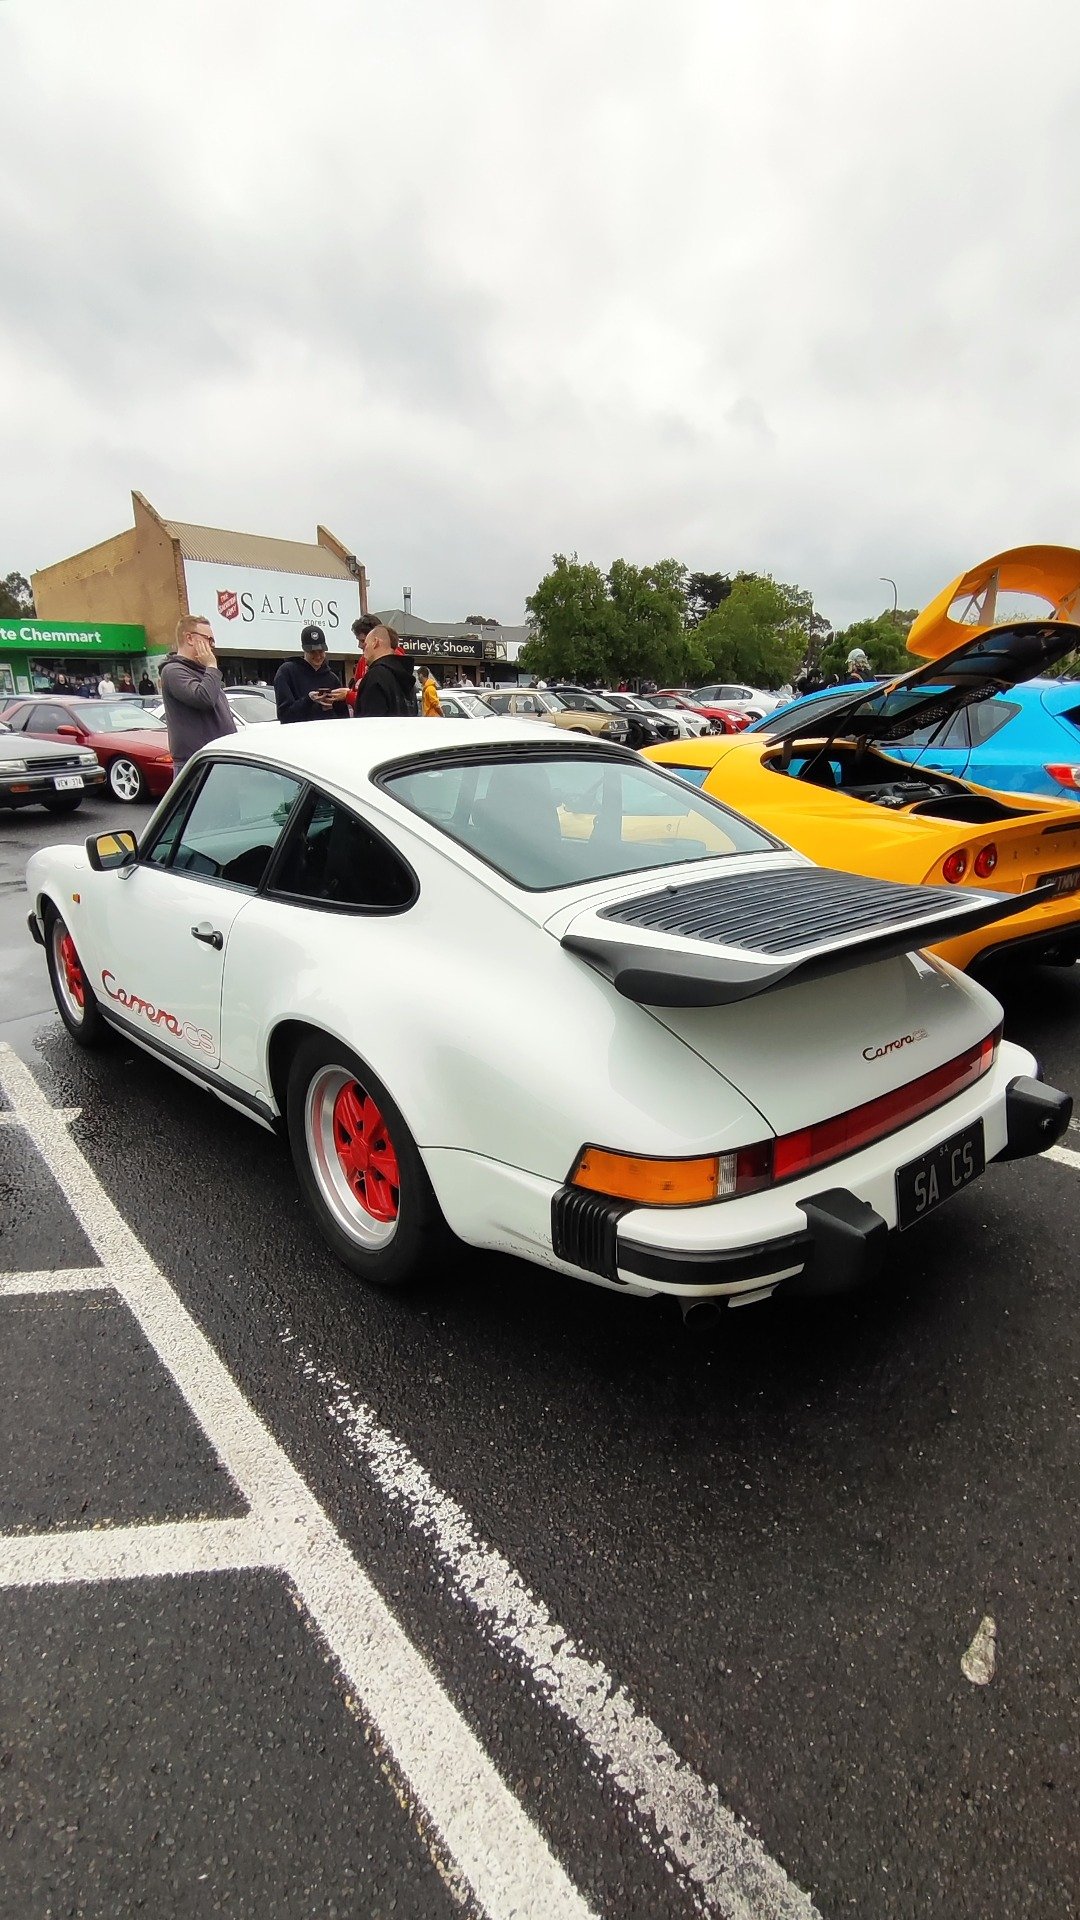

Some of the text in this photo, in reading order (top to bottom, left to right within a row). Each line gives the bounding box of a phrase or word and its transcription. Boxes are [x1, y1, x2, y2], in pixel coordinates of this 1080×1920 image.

[240, 592, 340, 628] SALVOS
[303, 619, 326, 627] stores
[20, 627, 102, 643] Chemmart
[397, 638, 440, 652] Fairley's
[443, 641, 475, 653] Shoex
[101, 969, 183, 1037] Carrera
[914, 1141, 974, 1212] SA CS
